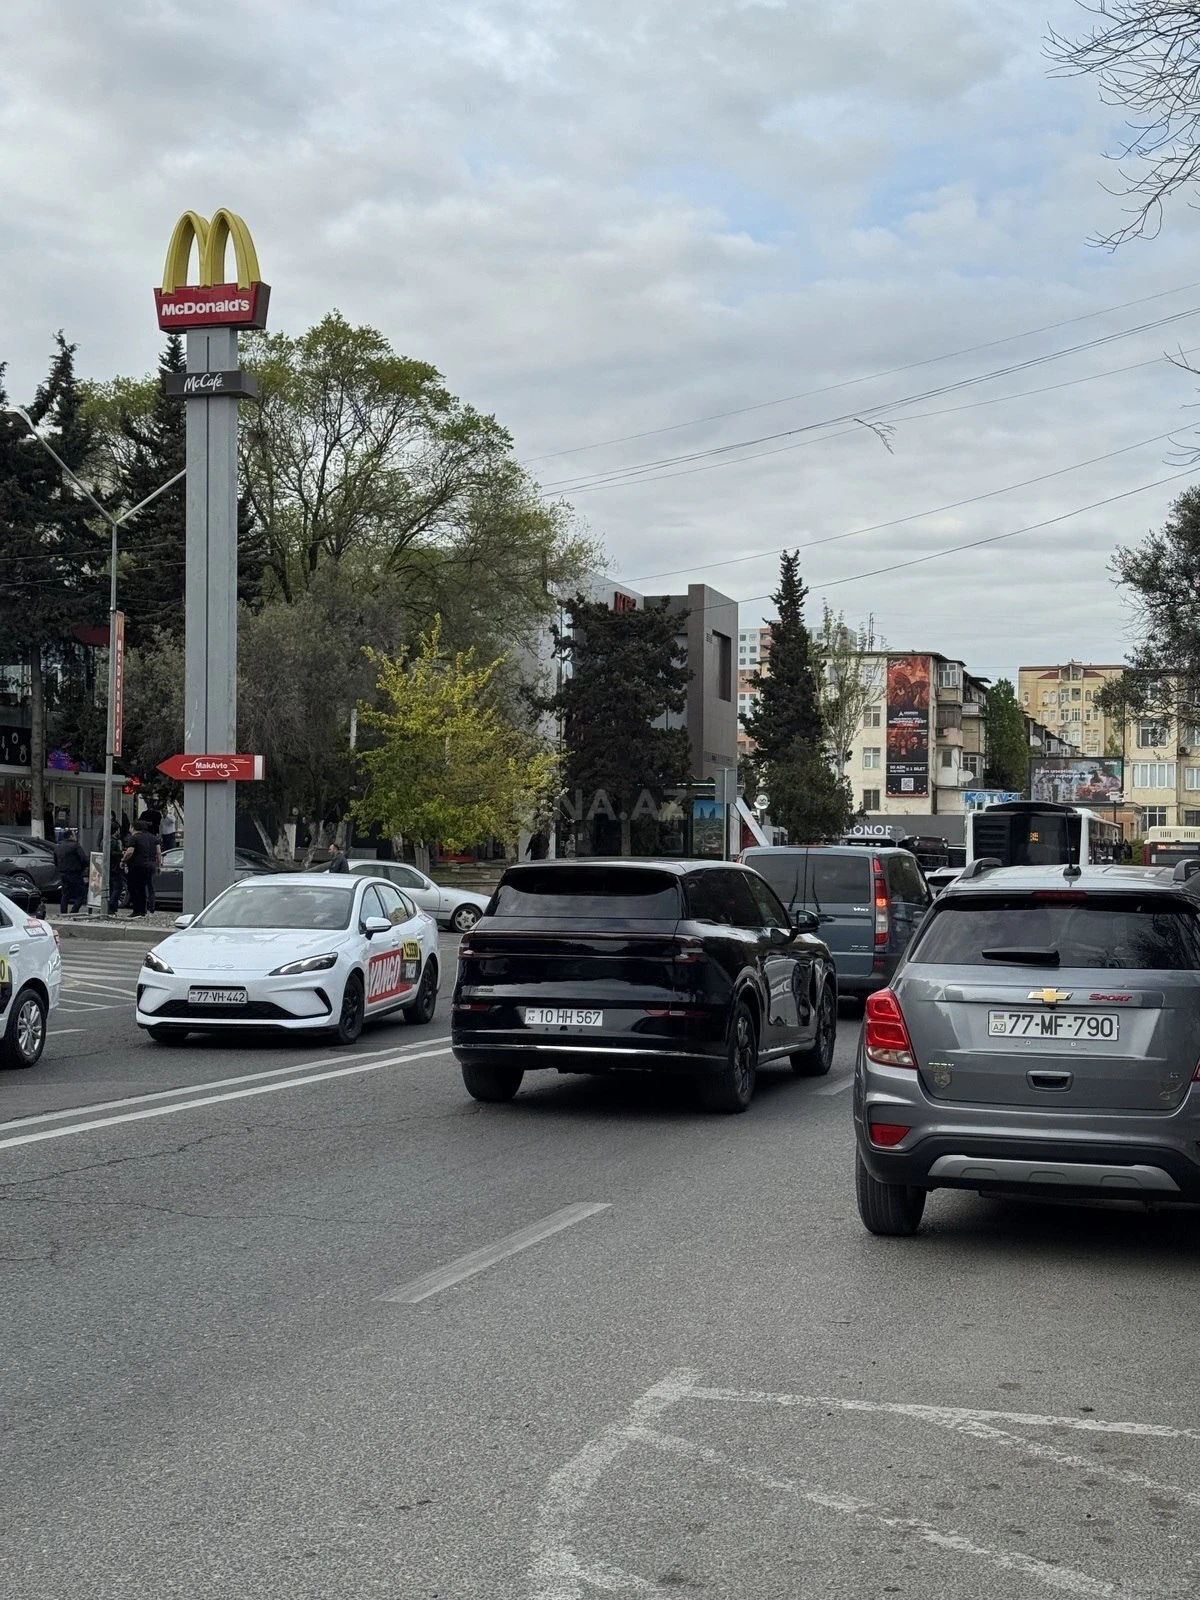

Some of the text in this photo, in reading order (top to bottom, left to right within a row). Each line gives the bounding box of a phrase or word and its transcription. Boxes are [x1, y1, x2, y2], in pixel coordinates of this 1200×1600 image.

[161, 298, 250, 316] McDonald's
[184, 373, 224, 392] McCafé
[369, 954, 400, 997] YANGO
[197, 992, 245, 1003] 77-VH-442
[539, 1011, 601, 1025] 10 HH 567
[1008, 1014, 1114, 1037] 77-MF-790
